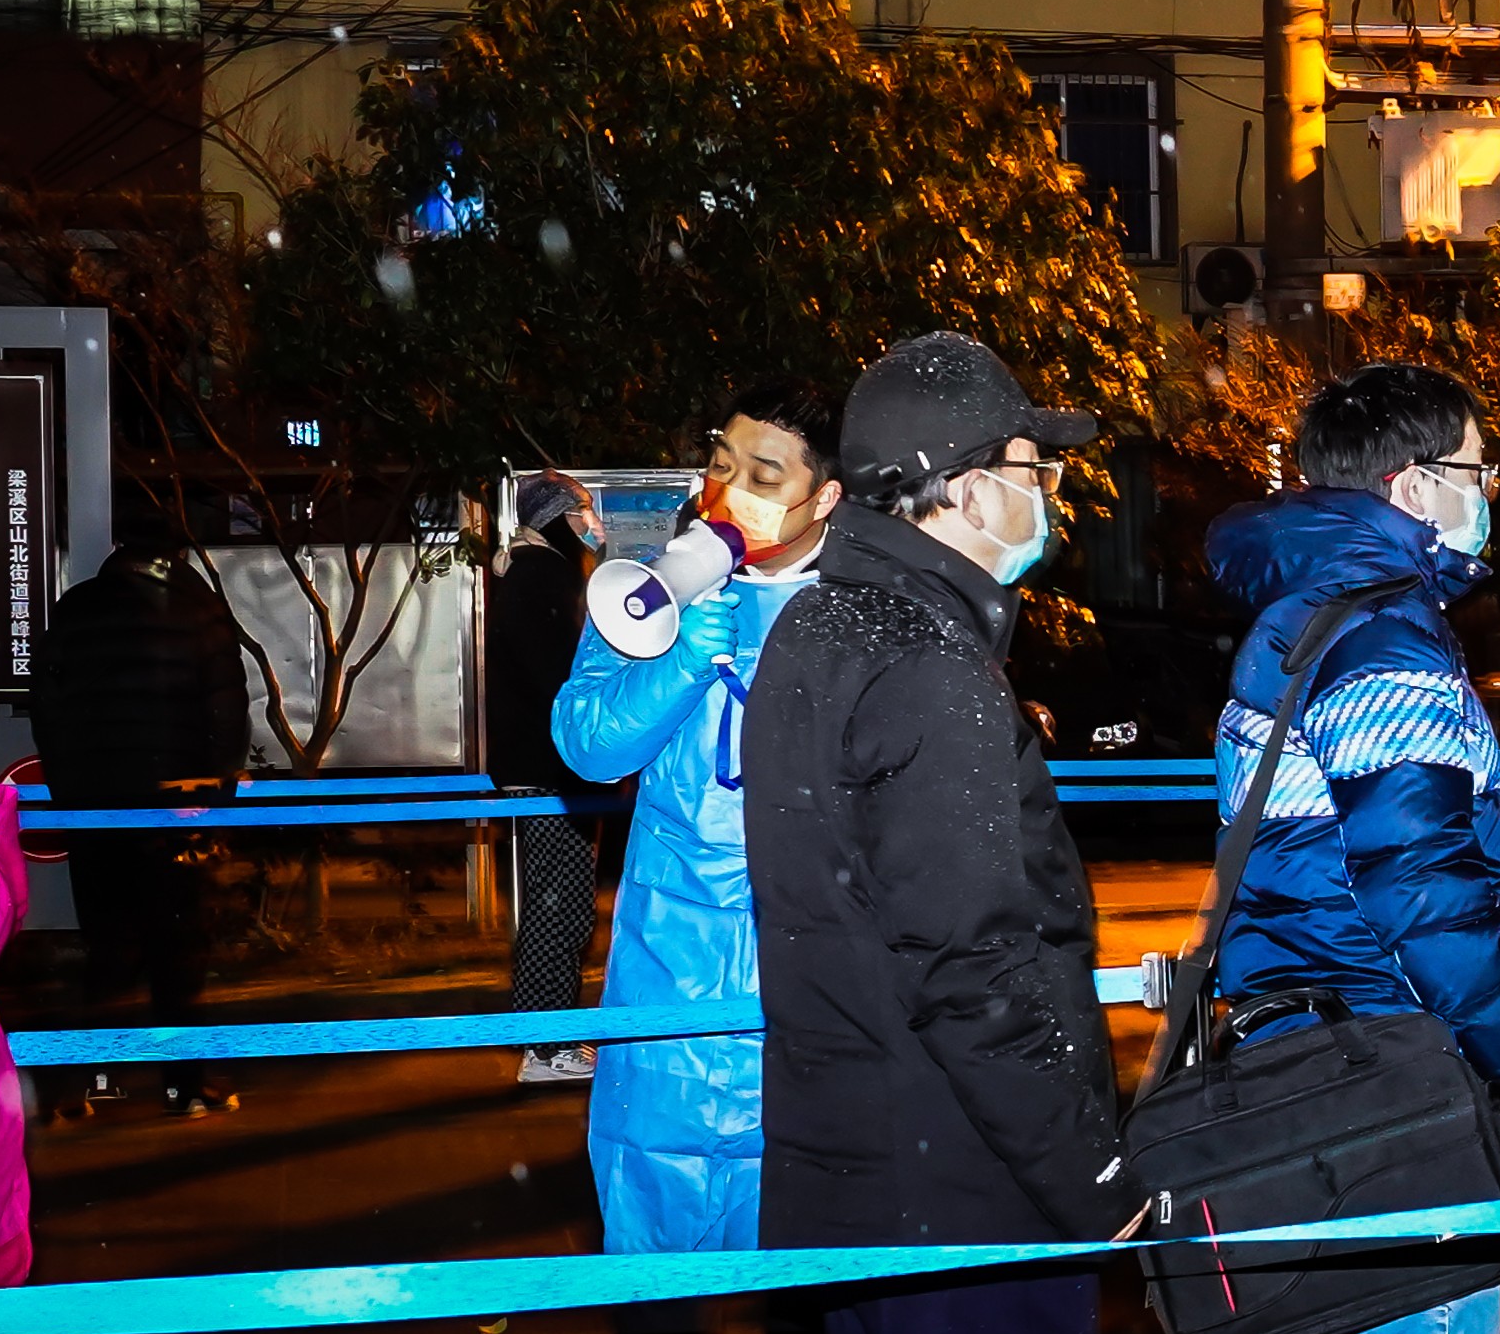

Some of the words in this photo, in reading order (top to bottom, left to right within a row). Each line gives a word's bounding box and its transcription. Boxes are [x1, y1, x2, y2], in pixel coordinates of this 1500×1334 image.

[8, 469, 32, 676] 梁溪区山北街道惠峰社区
